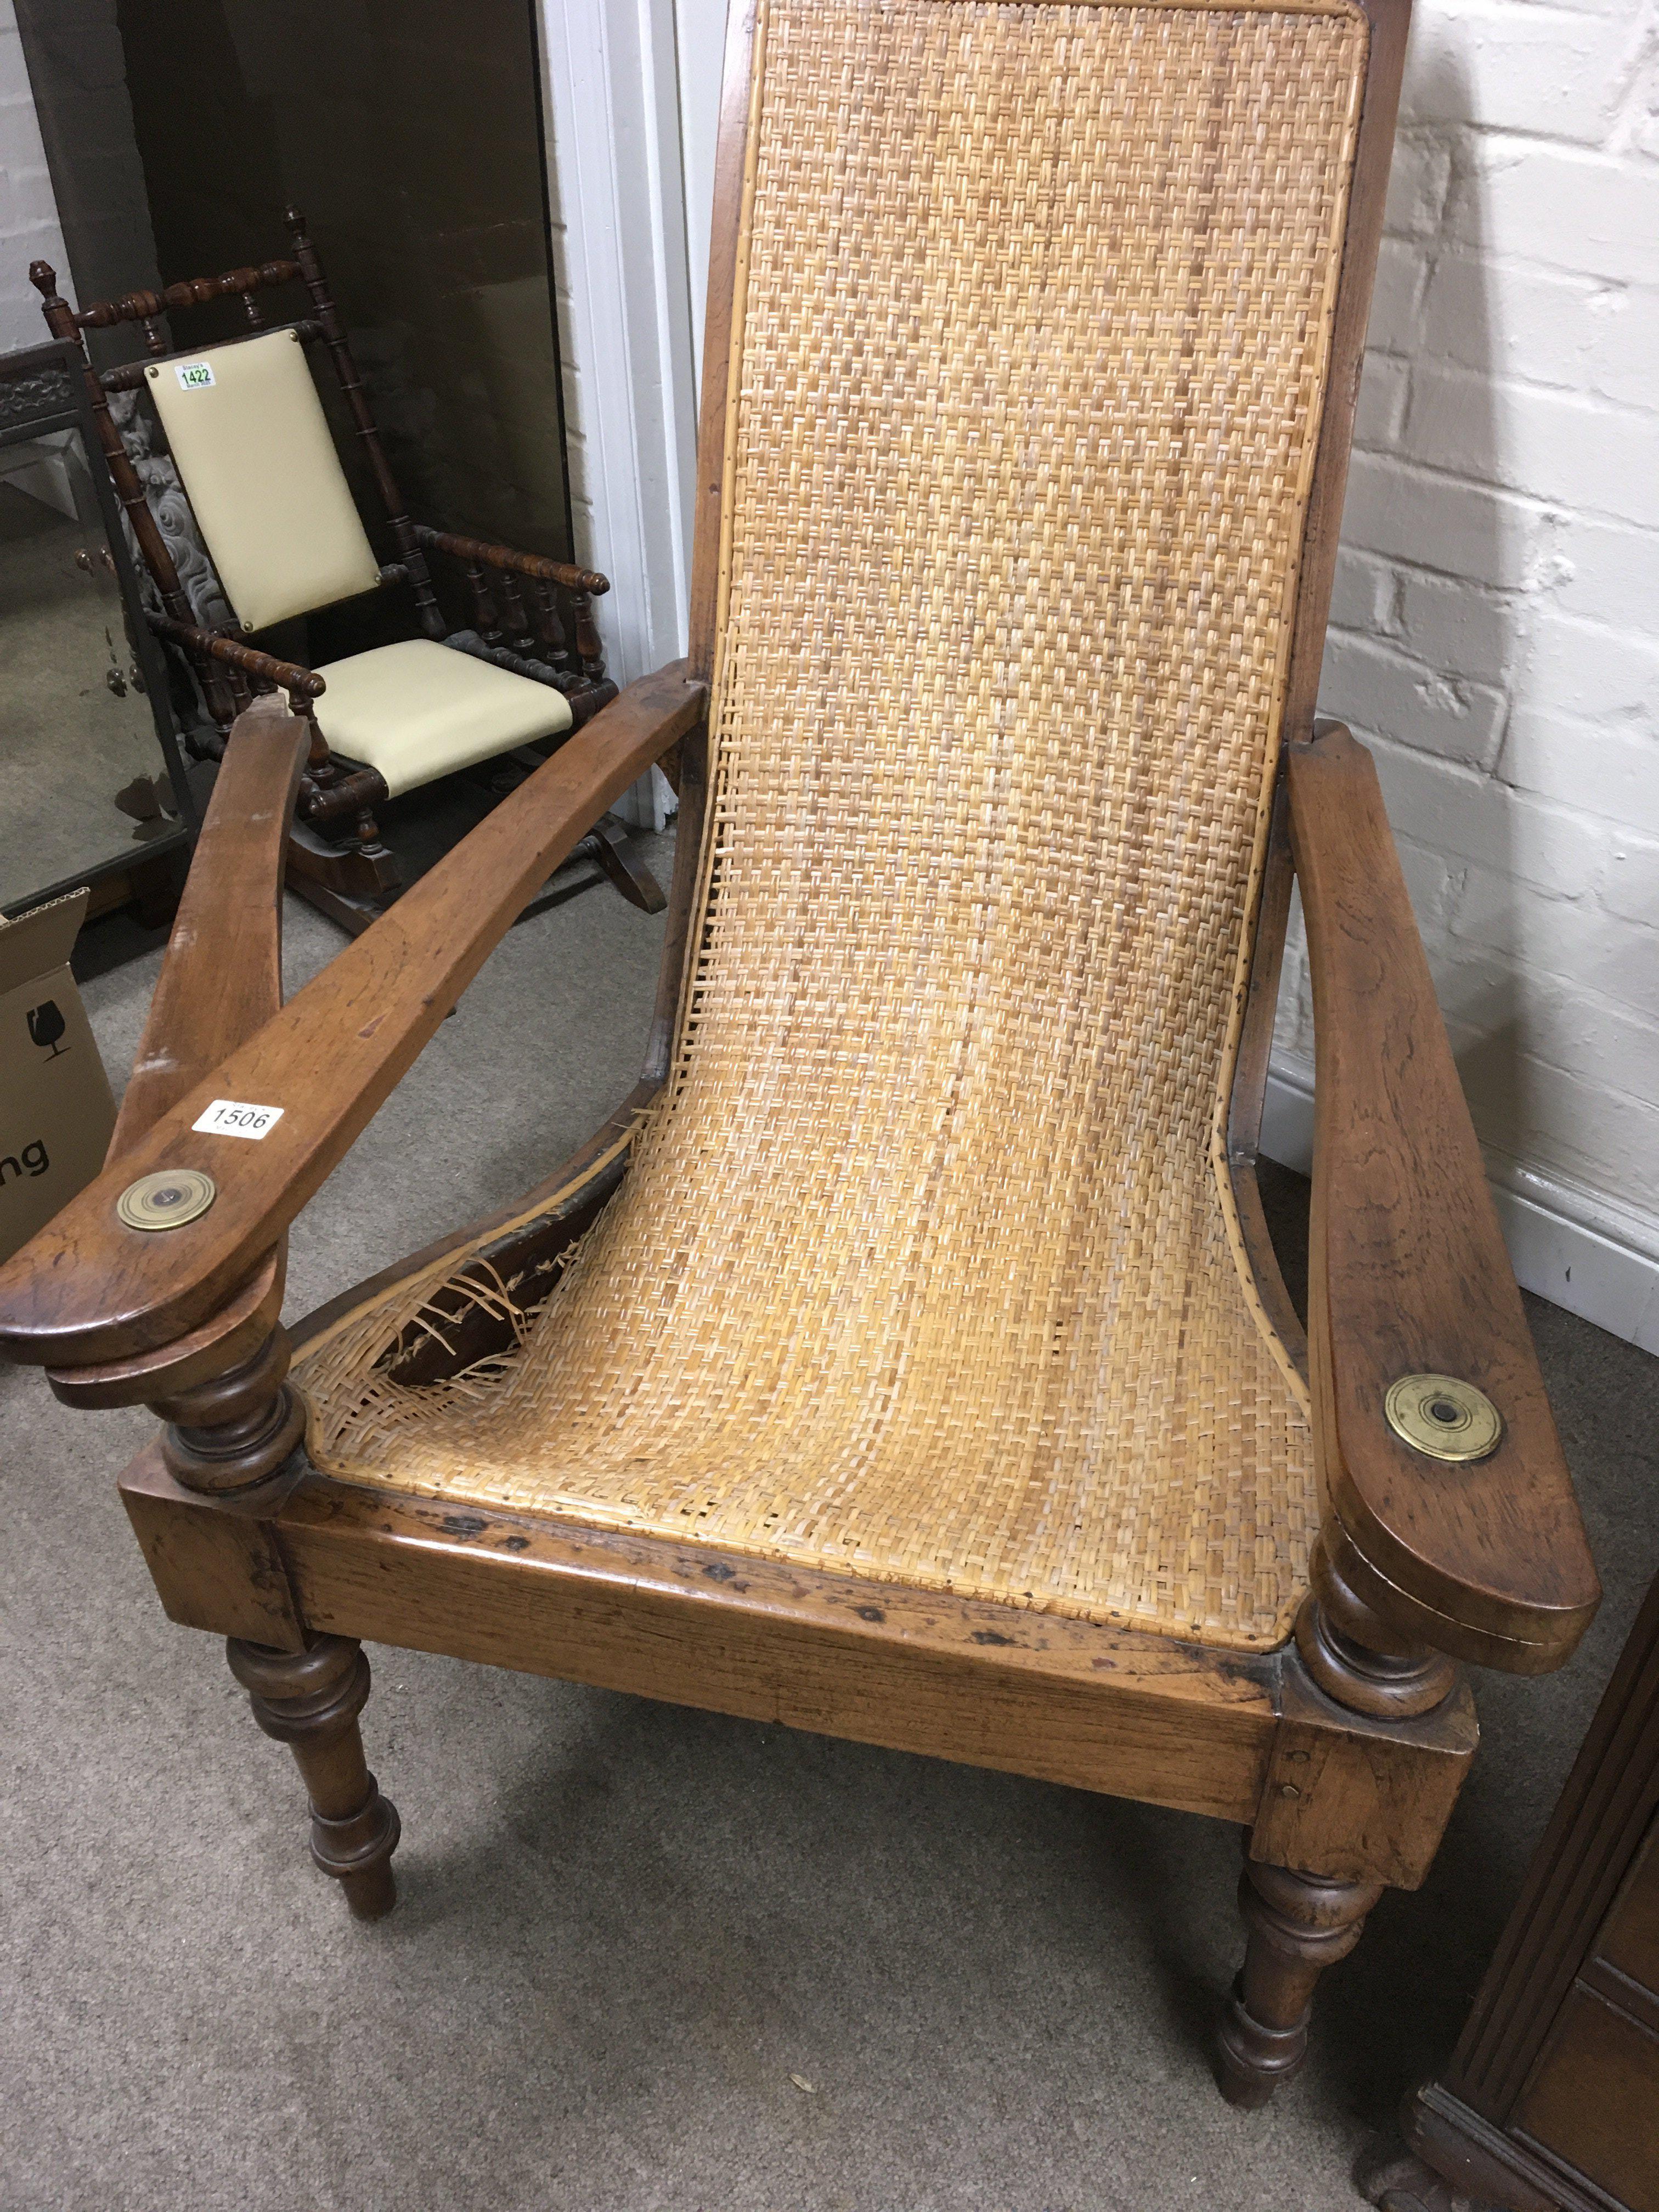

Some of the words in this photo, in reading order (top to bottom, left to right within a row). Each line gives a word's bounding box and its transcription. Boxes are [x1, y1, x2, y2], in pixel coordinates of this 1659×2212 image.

[182, 369, 211, 385] 1422
[214, 1108, 270, 1128] 1506
[0, 1139, 49, 1186] ng
